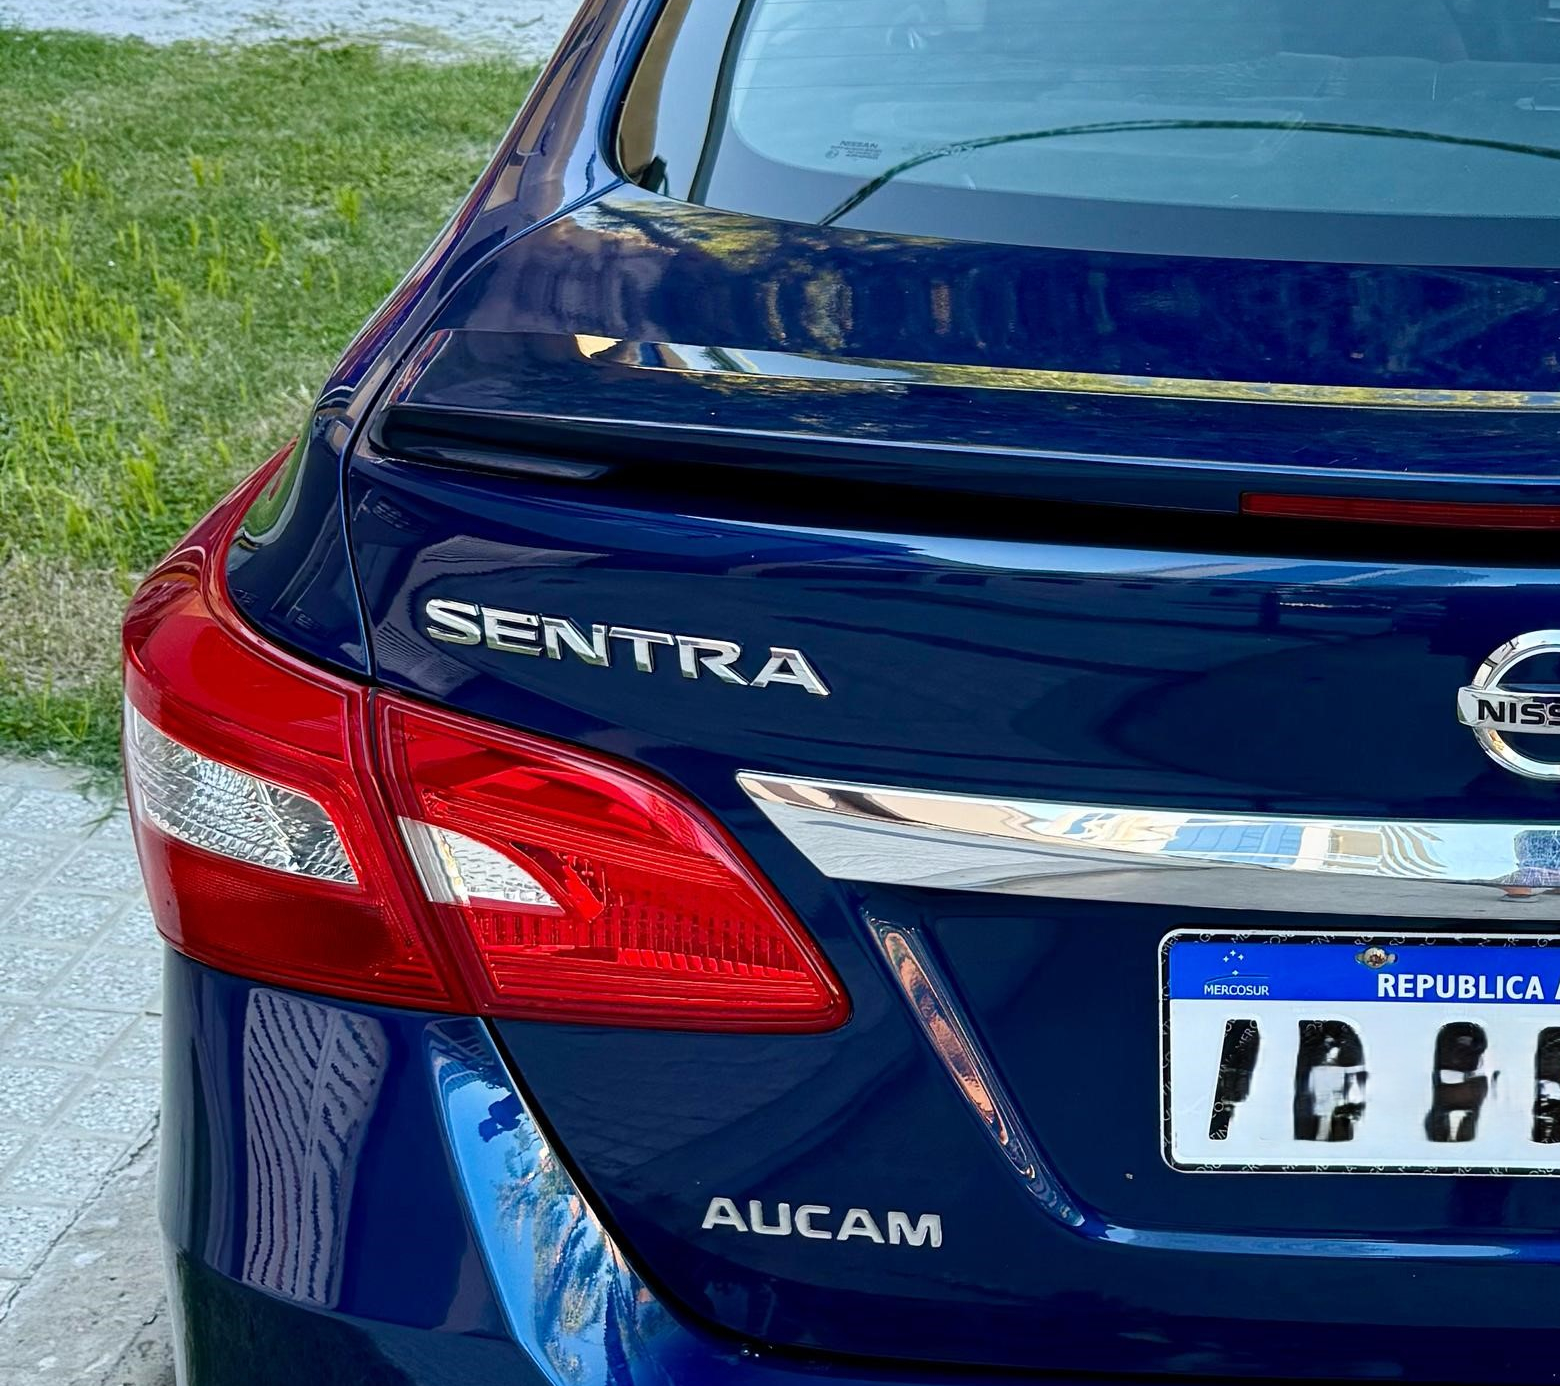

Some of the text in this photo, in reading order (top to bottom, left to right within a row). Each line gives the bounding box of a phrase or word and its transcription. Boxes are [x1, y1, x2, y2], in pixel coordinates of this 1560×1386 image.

[425, 598, 831, 696] SENTRA
[1203, 984, 1269, 997] MERCOSUR
[1377, 973, 1545, 1000] REPUBLICA
[701, 1196, 943, 1247] AUCAM
